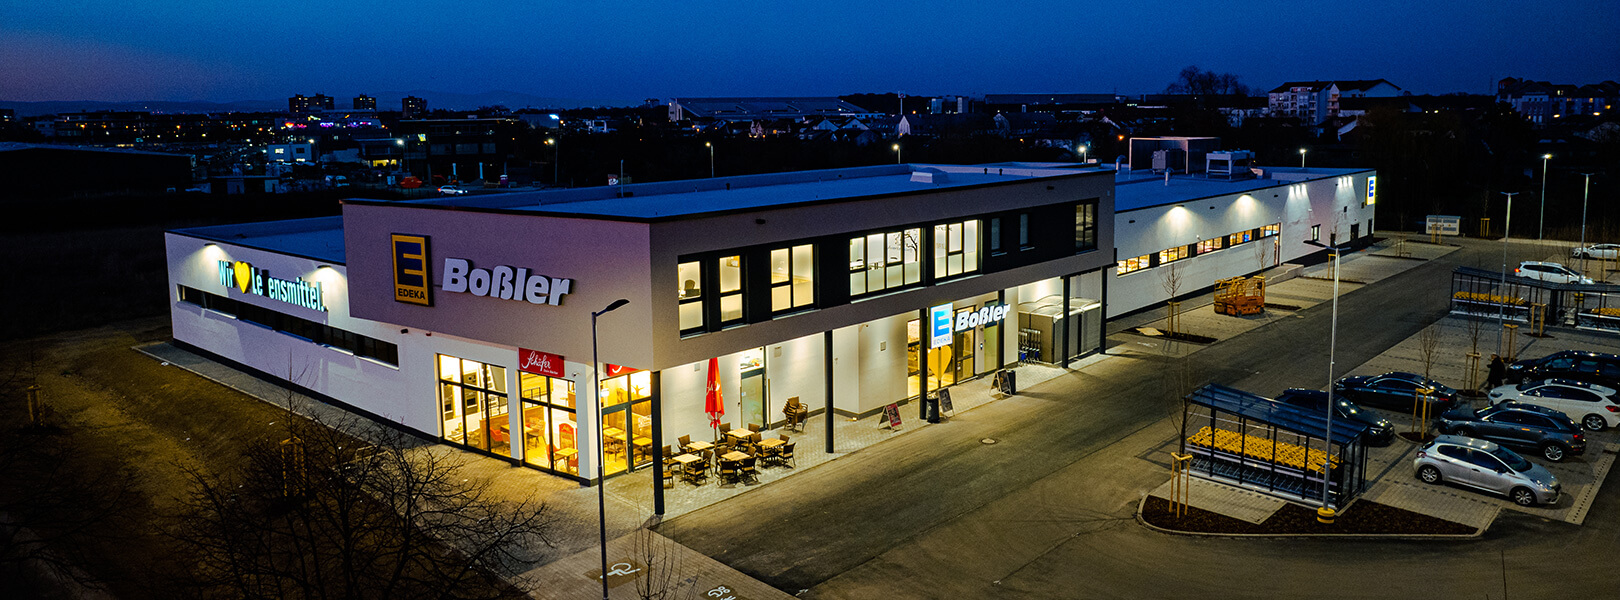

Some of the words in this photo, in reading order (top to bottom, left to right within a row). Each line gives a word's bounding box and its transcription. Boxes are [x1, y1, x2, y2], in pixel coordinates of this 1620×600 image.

[395, 241, 425, 288] E
[218, 260, 234, 288] Wir
[251, 267, 325, 312] Leensmittel.
[397, 287, 425, 300] EDEKA
[442, 258, 571, 306] Boßler
[934, 308, 950, 338] E
[955, 304, 1011, 332] Boßler
[521, 350, 552, 371] Schäfer
